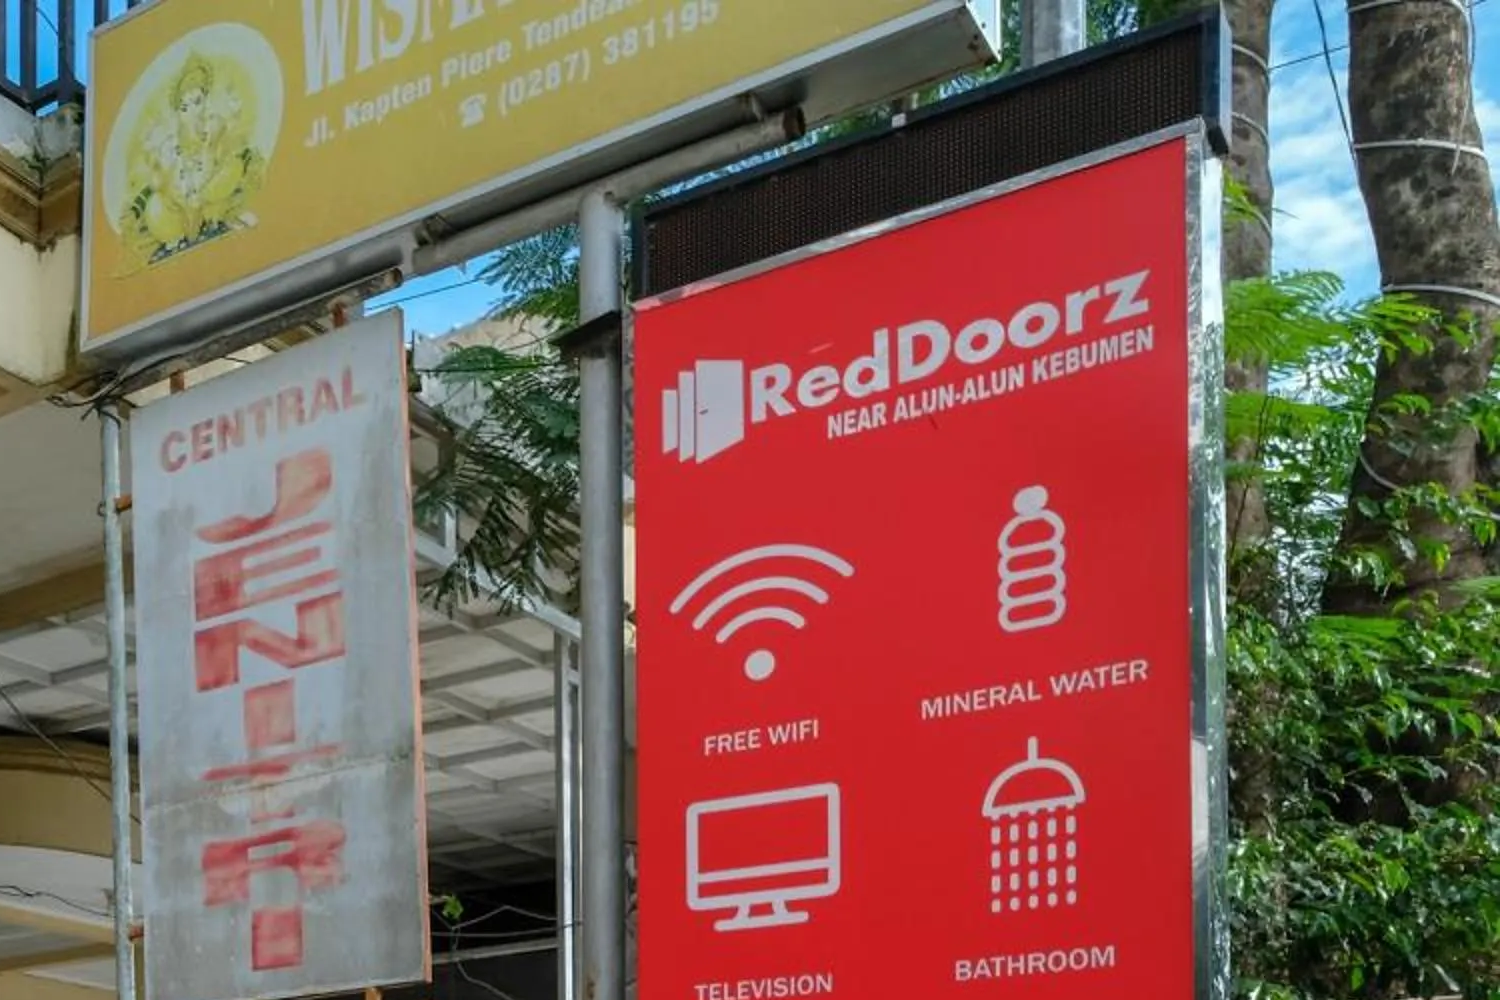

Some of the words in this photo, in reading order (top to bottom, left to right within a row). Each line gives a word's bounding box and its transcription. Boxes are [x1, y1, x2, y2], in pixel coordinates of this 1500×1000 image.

[344, 73, 433, 131] Kapten
[441, 37, 512, 88] Piere
[498, 48, 591, 119] (0287)
[749, 268, 1151, 425] RedDoorz
[827, 401, 888, 440] NEAR
[892, 362, 1026, 424] ALUN-ALUN
[1031, 323, 1155, 385] KEBUMEN
[160, 364, 367, 473] CENTRAL
[920, 678, 1043, 721] MINERAL
[1049, 658, 1150, 698] WATER
[703, 727, 762, 757] FREE
[766, 719, 820, 745] WIFI
[954, 944, 1116, 982] BATHROOM
